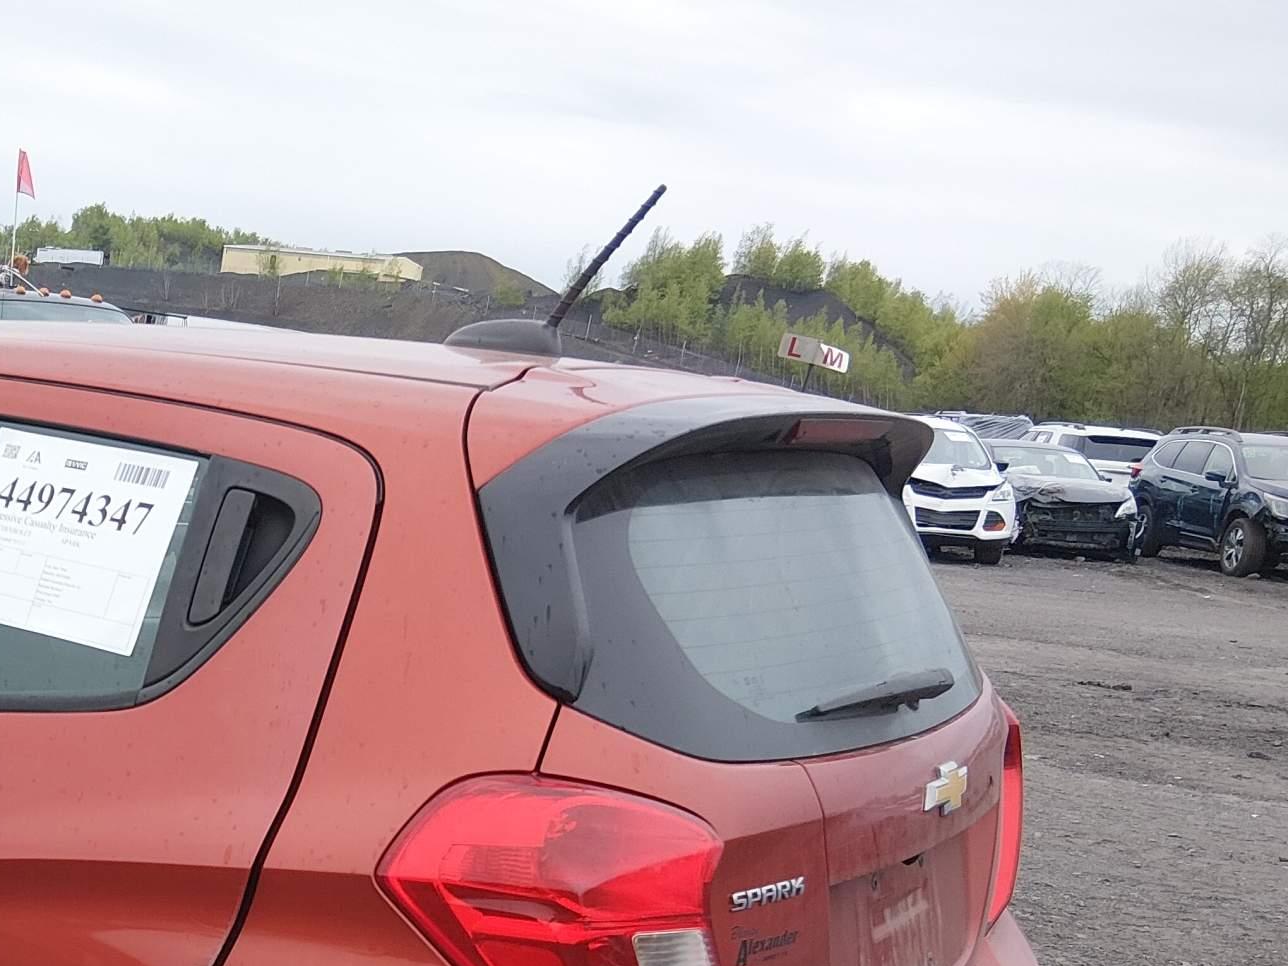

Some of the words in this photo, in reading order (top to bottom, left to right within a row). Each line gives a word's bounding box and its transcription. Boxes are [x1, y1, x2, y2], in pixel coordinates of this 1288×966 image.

[787, 337, 801, 358] L
[823, 348, 843, 368] M
[59, 522, 97, 541] Insurance
[729, 876, 806, 912] SPARK
